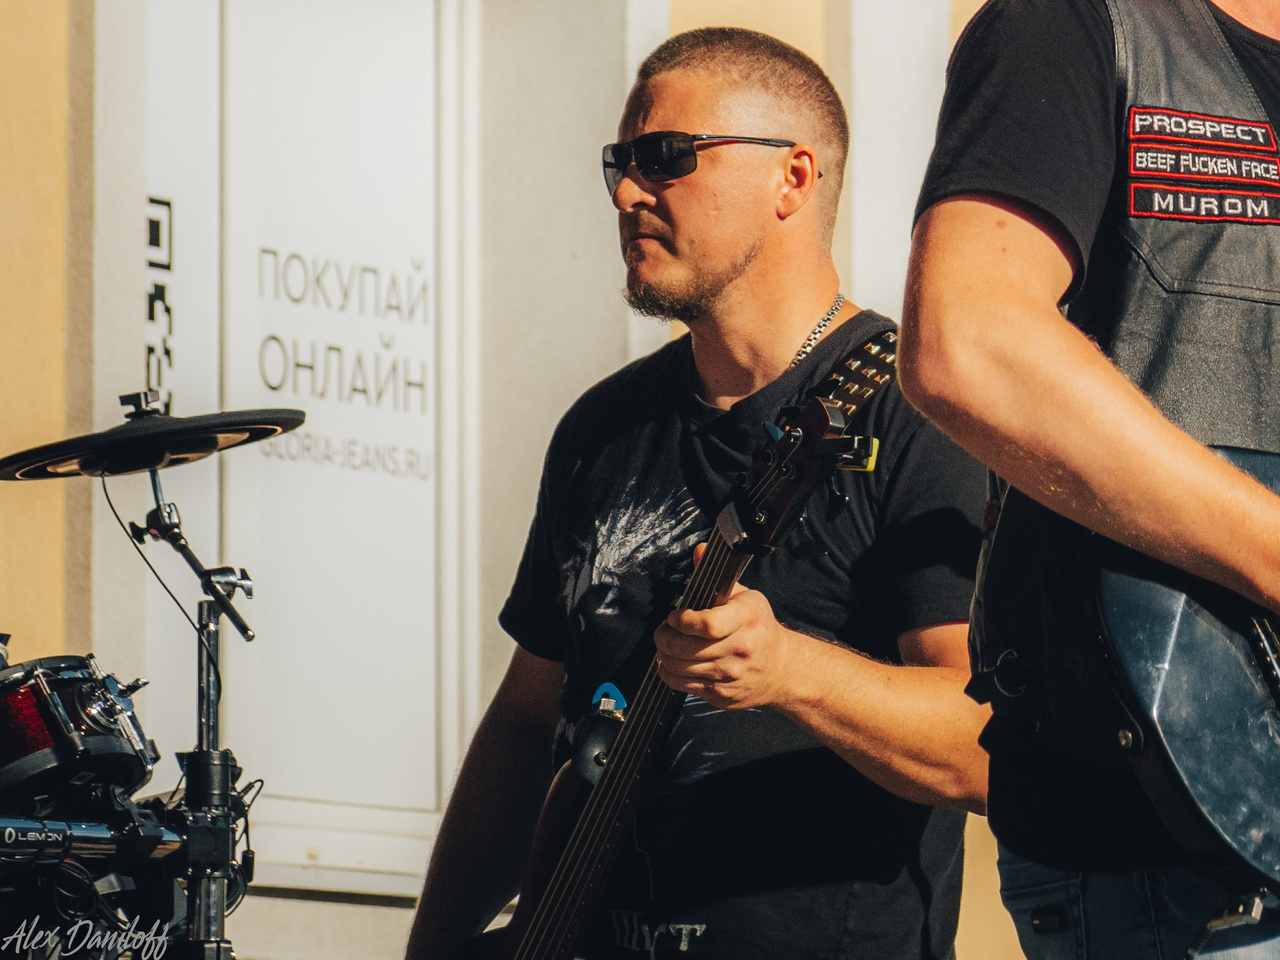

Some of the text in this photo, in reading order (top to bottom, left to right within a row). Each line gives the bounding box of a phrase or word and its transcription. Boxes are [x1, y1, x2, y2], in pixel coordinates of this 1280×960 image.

[1134, 114, 1266, 144] PROSPECT
[1135, 152, 1280, 181] BEEF FUCKEN FACE
[1153, 192, 1269, 218] MUROM
[258, 247, 431, 327] ПОКУПАЙ
[258, 333, 428, 416] ОНЛАЙН
